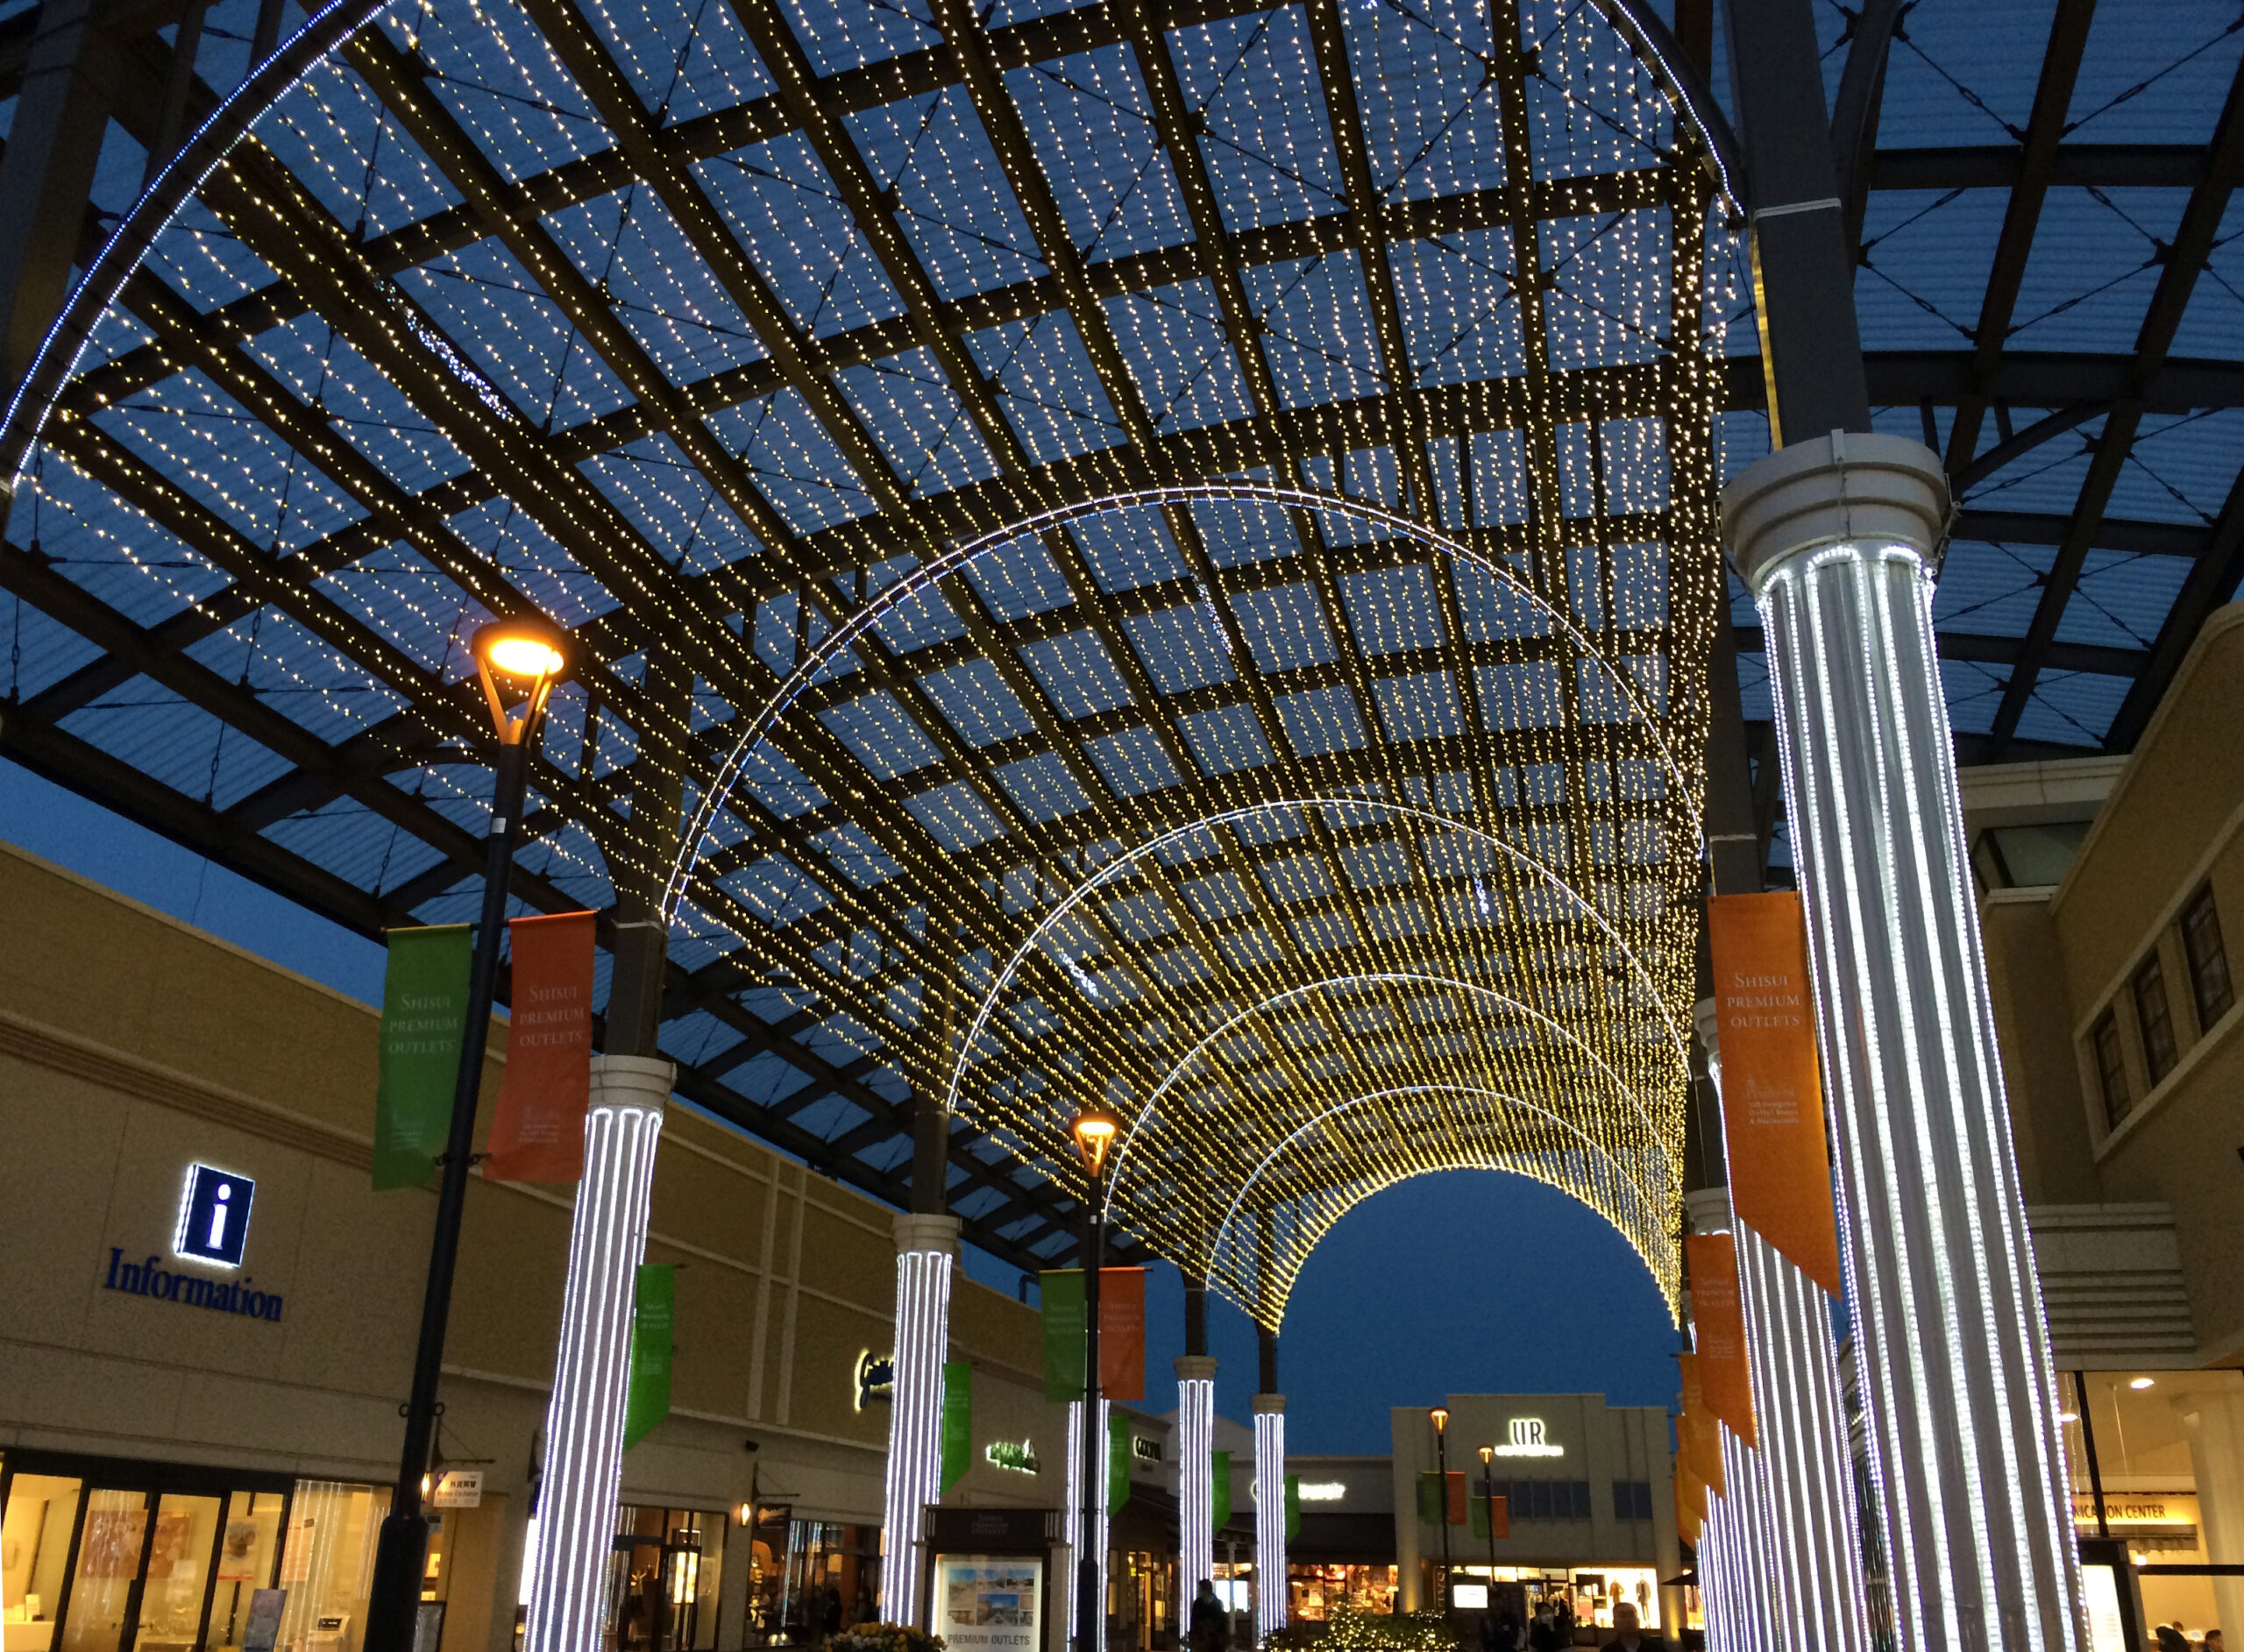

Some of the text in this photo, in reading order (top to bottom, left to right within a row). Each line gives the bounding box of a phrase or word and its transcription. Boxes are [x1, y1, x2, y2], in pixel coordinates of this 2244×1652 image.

[1727, 995, 1800, 1008] PREMIUM
[519, 1008, 585, 1025] PREMIUM
[1730, 1015, 1800, 1028] OUTLETS
[389, 1017, 458, 1032] PREMIUM
[388, 1039, 456, 1054] OUTLETS
[520, 1031, 583, 1047] OUTLETS
[103, 1247, 283, 1322] Information
[1513, 1422, 1542, 1445] UR
[2125, 1504, 2166, 1519] CENTER
[948, 1634, 1030, 1646] PREMIUM OUTLETS
